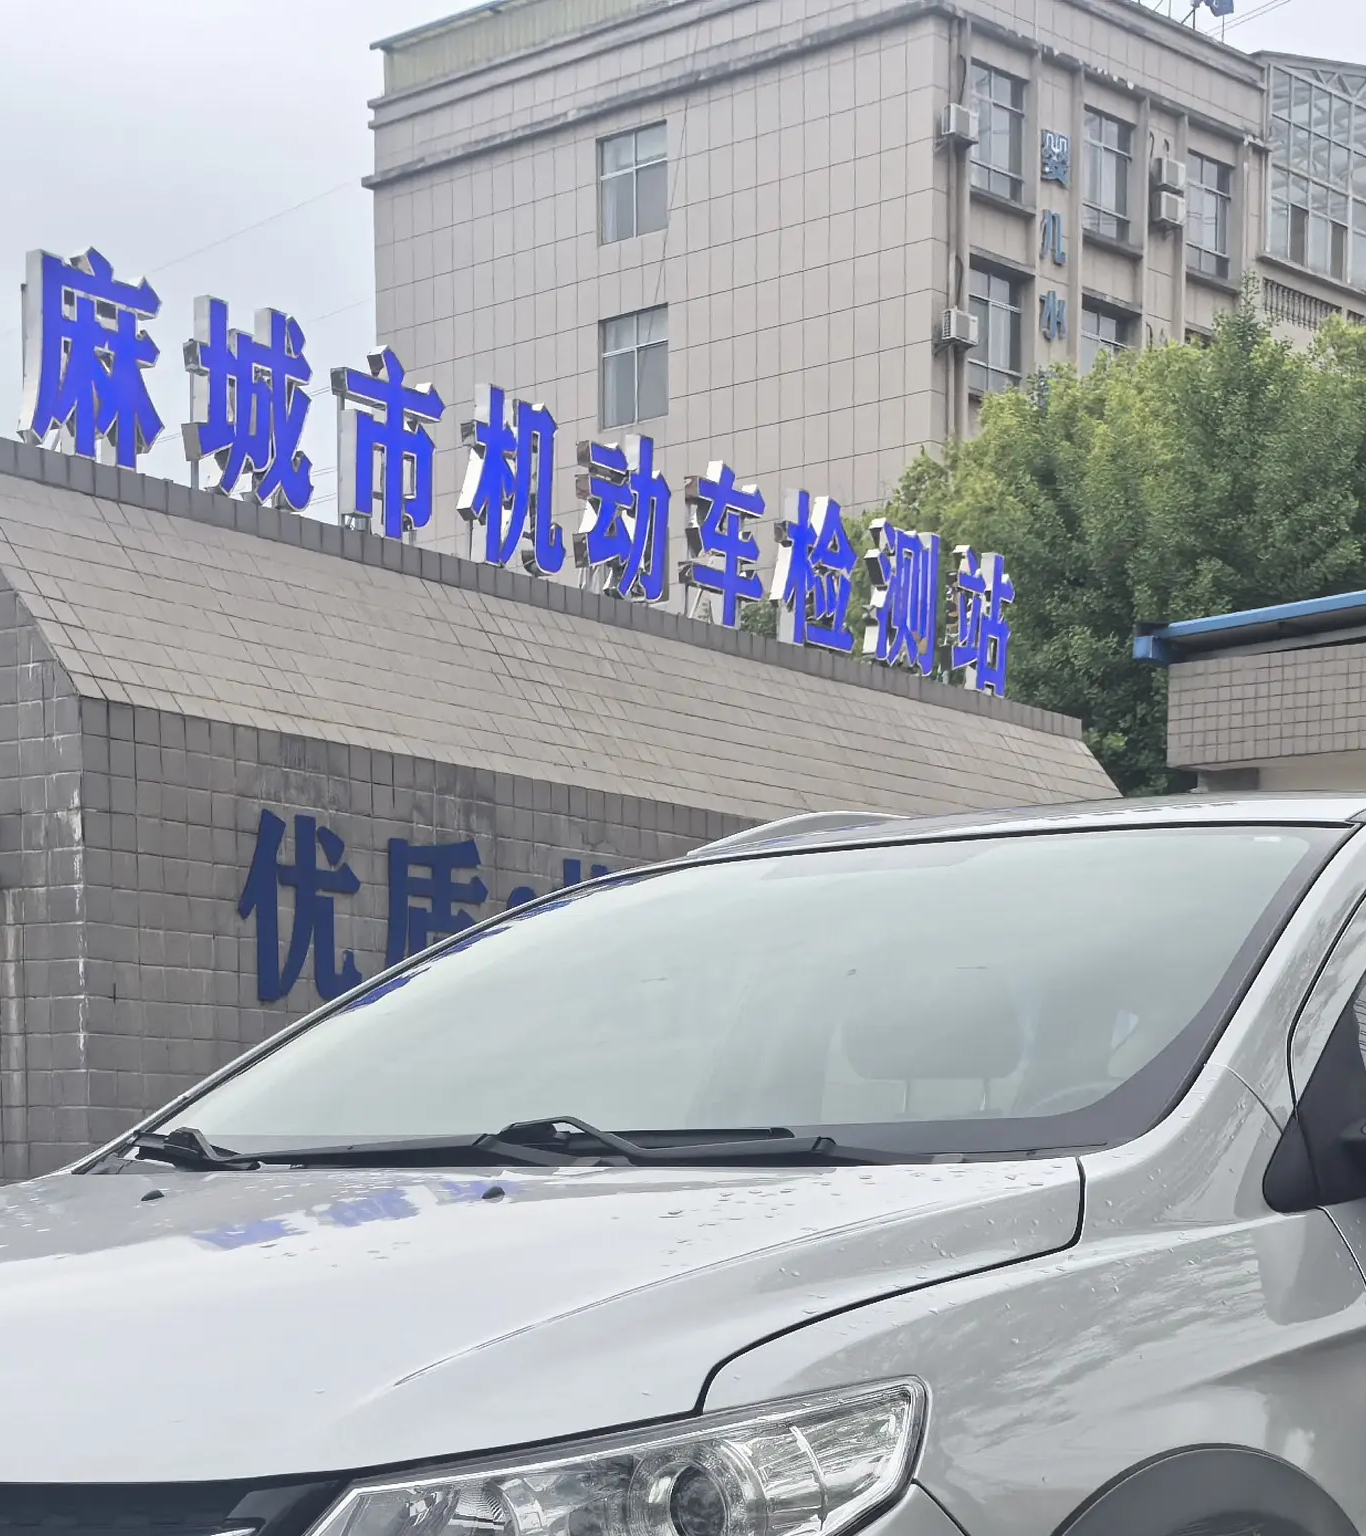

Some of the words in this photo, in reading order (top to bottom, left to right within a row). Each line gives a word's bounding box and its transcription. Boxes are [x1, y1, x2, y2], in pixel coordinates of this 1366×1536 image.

[27, 246, 1015, 698] 麻城市机动车检测站
